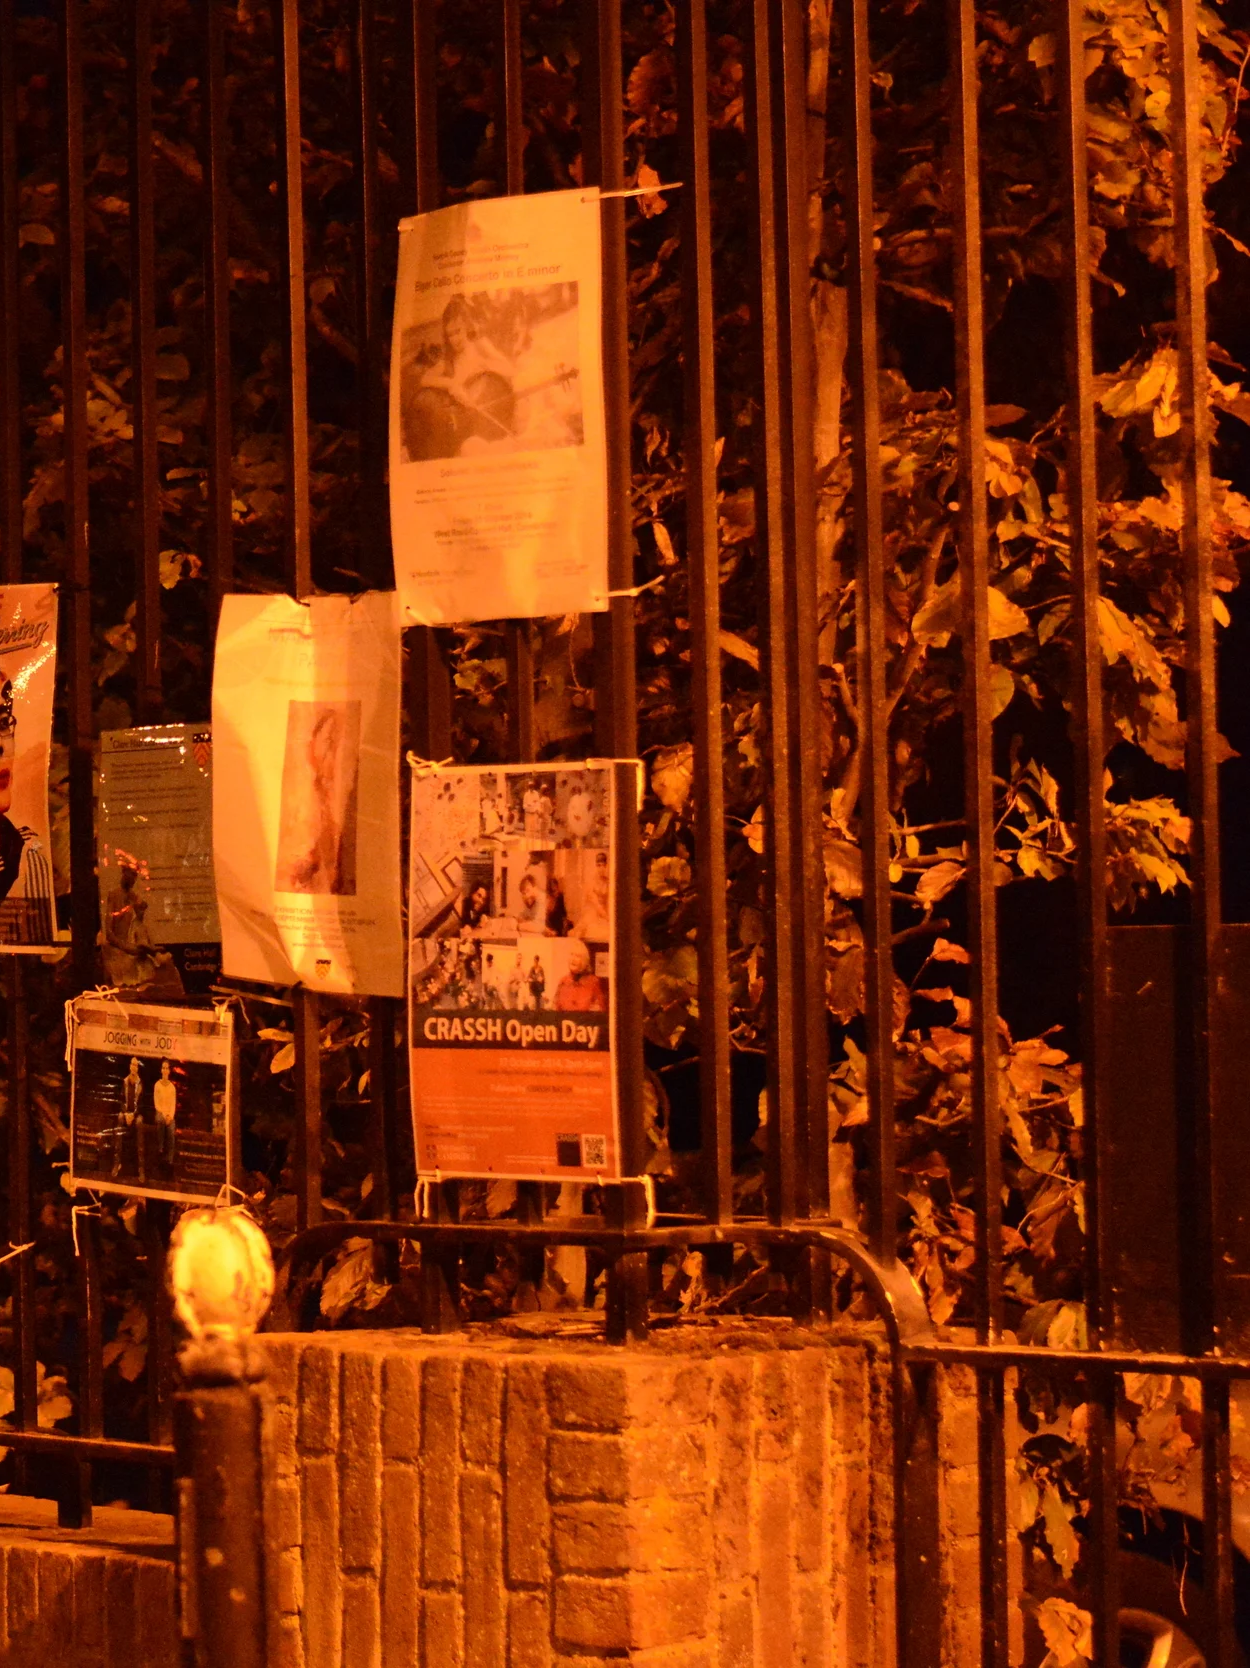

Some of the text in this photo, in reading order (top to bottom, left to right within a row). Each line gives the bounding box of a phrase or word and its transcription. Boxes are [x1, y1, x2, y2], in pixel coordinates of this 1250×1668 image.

[453, 271, 500, 286] Concerto
[516, 266, 525, 278] E
[527, 263, 561, 277] minor
[102, 1030, 138, 1047] JOGGING
[424, 1017, 600, 1049] CRASSH Open Day
